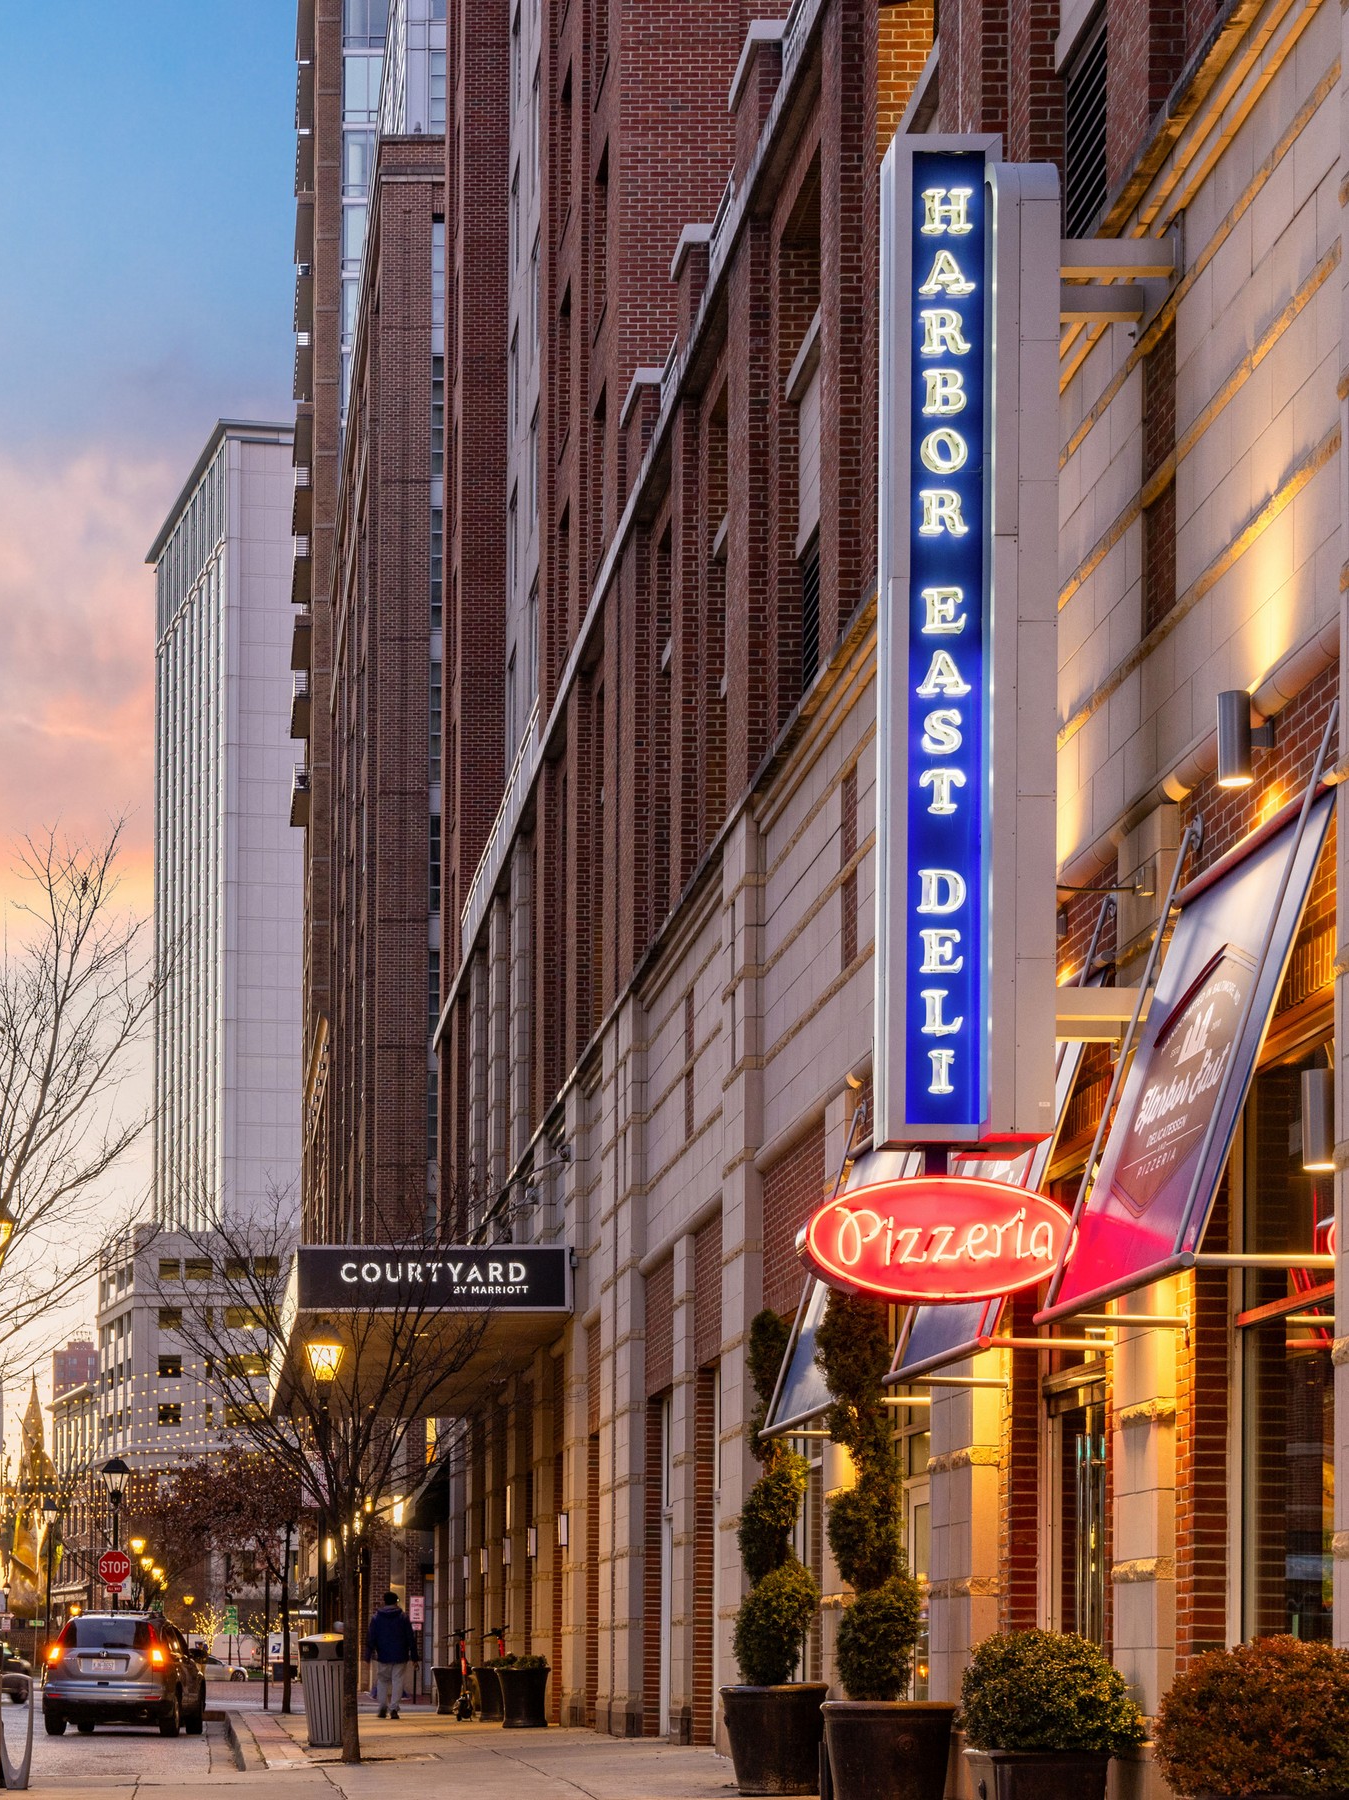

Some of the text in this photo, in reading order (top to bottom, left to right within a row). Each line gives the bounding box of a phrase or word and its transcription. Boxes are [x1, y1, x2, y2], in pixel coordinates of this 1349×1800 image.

[916, 188, 975, 1095] HARBOR EAST DELI
[1134, 1042, 1231, 1136] Harbor East
[1146, 1113, 1189, 1148] DELICATESSEN
[1136, 1147, 1177, 1179] PIZZERIA
[835, 1207, 1054, 1266] Pizzeria
[340, 1262, 527, 1283] COURTYARD
[453, 1286, 529, 1294] BY MARRIOTT
[101, 1561, 128, 1573] STOP
